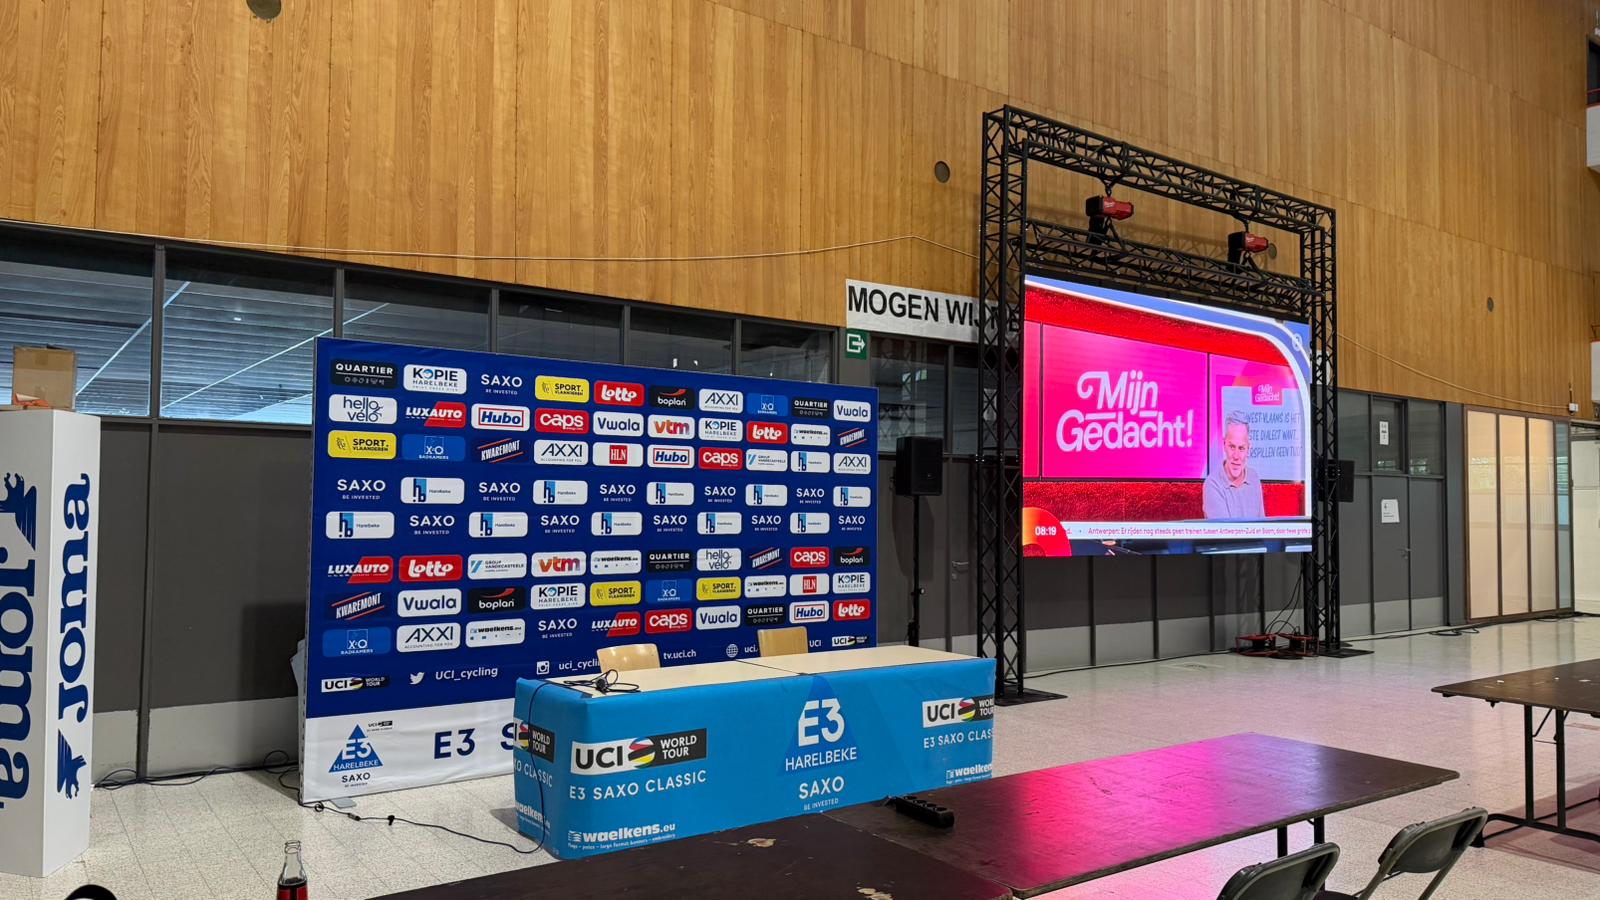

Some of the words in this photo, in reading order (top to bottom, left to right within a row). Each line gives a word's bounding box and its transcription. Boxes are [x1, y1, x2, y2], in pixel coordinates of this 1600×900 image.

[848, 285, 939, 323] MOGEN
[336, 363, 393, 375] QUARTIER
[413, 367, 458, 381] KOPIE
[412, 380, 458, 388] HARELBEKE
[481, 374, 523, 387] SAXO
[705, 392, 739, 406] AXXI
[1077, 370, 1159, 417] Mijn
[343, 396, 380, 410] hello
[657, 396, 686, 407] boplan
[794, 400, 828, 408] QUARTIER
[405, 407, 463, 418] LUXAUTO
[482, 411, 522, 424] Hubo
[836, 405, 868, 418] Vwala
[540, 413, 584, 430] caps
[597, 417, 640, 431] Vwala
[654, 420, 690, 435] vtm
[705, 420, 737, 431] KOPIE
[1056, 409, 1193, 452] Gedacht!
[481, 440, 520, 461] KWAREMONT
[541, 443, 582, 457] AXXI
[610, 448, 626, 460] HLN
[655, 451, 687, 463] Hubo
[703, 452, 739, 467] caps
[838, 456, 867, 467] AXXI
[337, 479, 386, 492] SAXO
[479, 482, 520, 494] SAXO
[600, 484, 636, 495] SAXO
[704, 486, 736, 496] SAXO
[796, 488, 824, 498] SAXO
[409, 515, 455, 527] SAXO
[541, 515, 580, 526] SAXO
[653, 515, 687, 526] SAXO
[751, 515, 781, 525] SAXO
[838, 515, 865, 525] SAXO
[1035, 526, 1056, 536] 08:19
[706, 550, 729, 560] hello
[752, 548, 780, 568] KWAREMONT
[794, 551, 826, 565] caps
[840, 556, 863, 565] boplan
[328, 563, 389, 574] LUXAUTO
[538, 556, 580, 573] vtm
[803, 579, 816, 590] HLN
[838, 575, 865, 583] KOPIE
[539, 585, 578, 597] KOPIE
[58, 473, 91, 723] Joma
[403, 595, 456, 611] Vwala
[479, 599, 514, 610] boplan
[336, 593, 382, 619] KWAREMONT
[747, 607, 783, 615] QUARTIER
[700, 611, 737, 624] Vwala
[796, 608, 823, 618] Hubo
[538, 618, 577, 631] SAXO
[592, 618, 637, 629] LUXAUTO
[649, 613, 688, 628] caps
[405, 626, 453, 643] AXXI
[663, 650, 697, 660] tv.uci.ch
[435, 667, 498, 681] UCI_cycling
[325, 680, 347, 690] UCI
[927, 703, 955, 722] UCI
[798, 698, 845, 747] E3
[434, 728, 476, 759] E3
[532, 731, 550, 745] WORLD
[660, 735, 697, 749] WORLD
[924, 737, 935, 748] E3
[938, 732, 964, 746] SAXO
[968, 728, 994, 741] CLAS
[342, 739, 372, 760] E3
[532, 741, 546, 755] TOUR
[663, 747, 689, 760] TOUR
[333, 759, 379, 770] HARELBEKE
[575, 746, 623, 770] UCI
[785, 747, 857, 771] HARELBEKE
[342, 772, 371, 783] SAXO
[524, 763, 553, 788] CLASSIC
[570, 785, 586, 800] E3
[593, 783, 639, 800] SAXO
[645, 770, 706, 793] CLASSIC
[799, 776, 845, 799] SAXO
[812, 798, 839, 809] INVESTED
[583, 823, 676, 843] waelkens.eu
